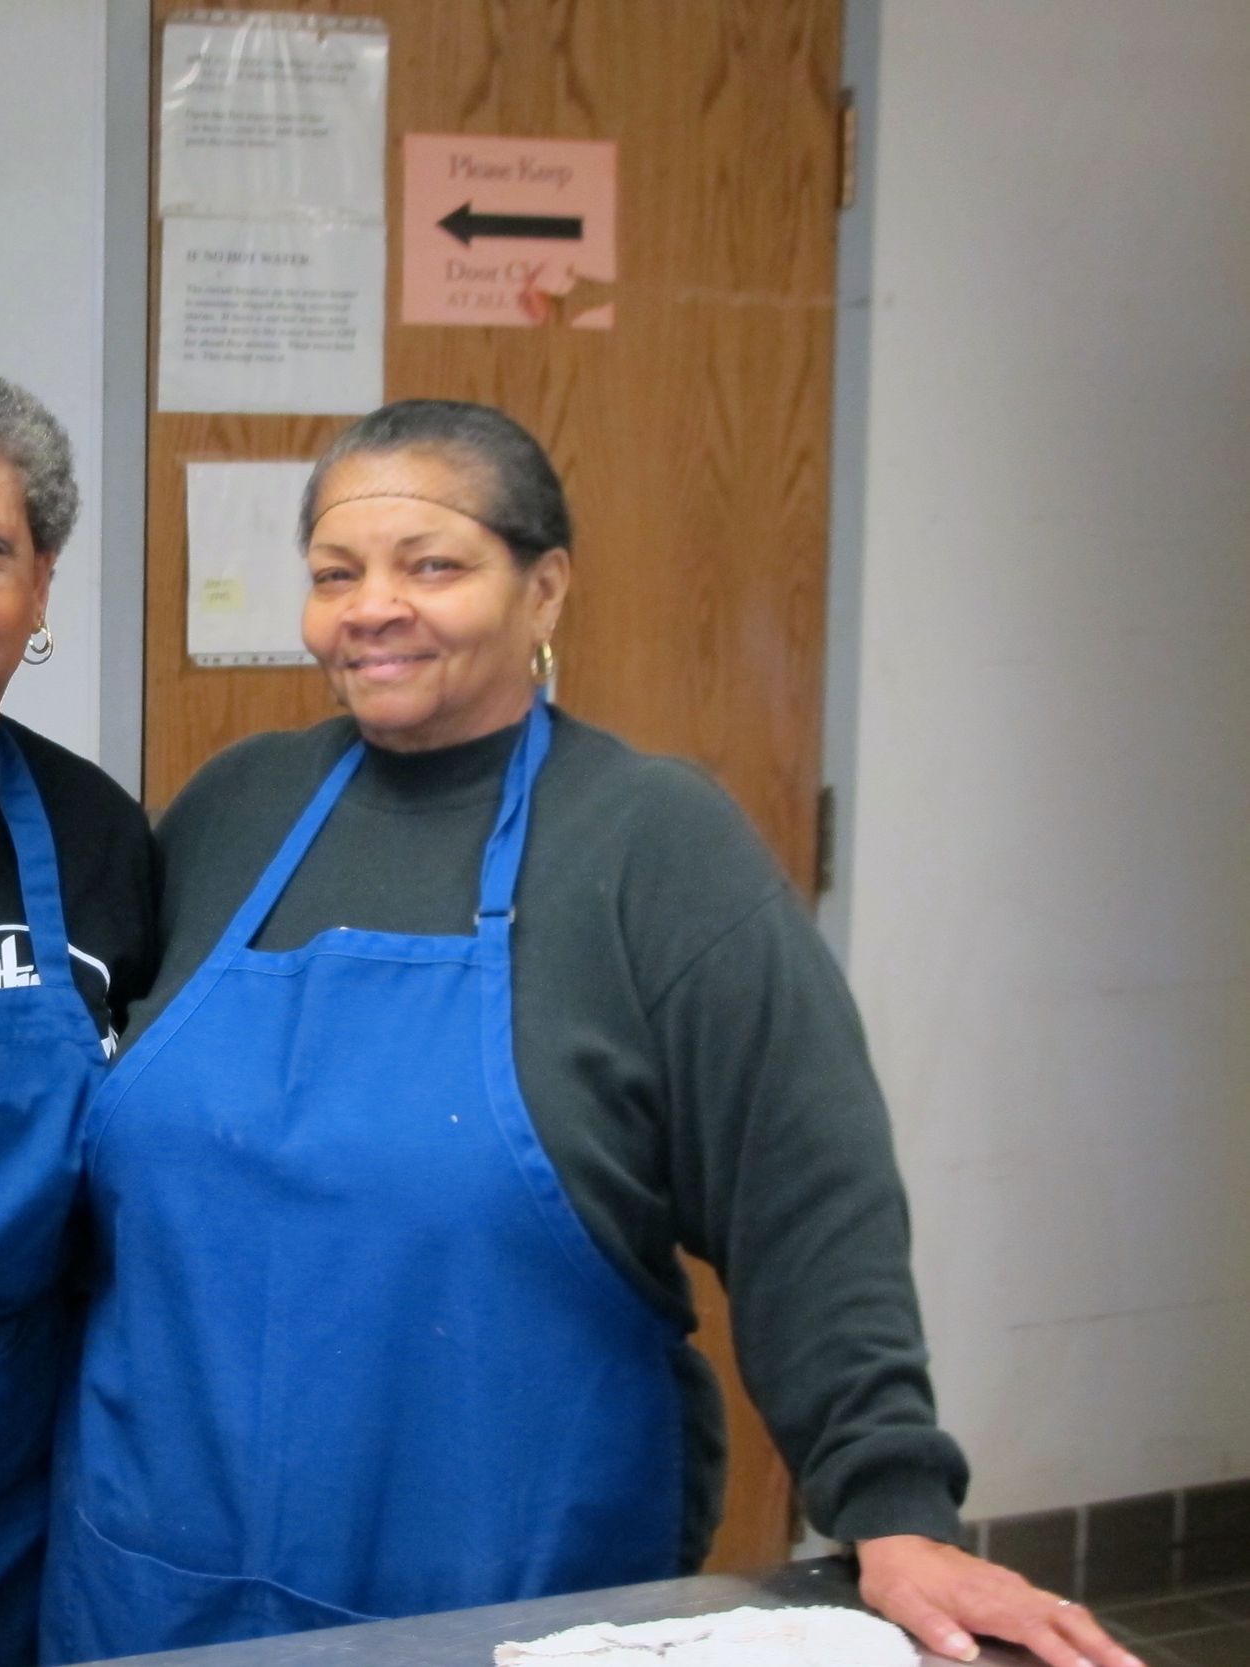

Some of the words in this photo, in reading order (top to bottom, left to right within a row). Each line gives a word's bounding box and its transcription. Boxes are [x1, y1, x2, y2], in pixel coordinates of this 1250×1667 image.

[450, 155, 511, 180] Please
[518, 158, 573, 190] Keep
[446, 258, 498, 282] Door
